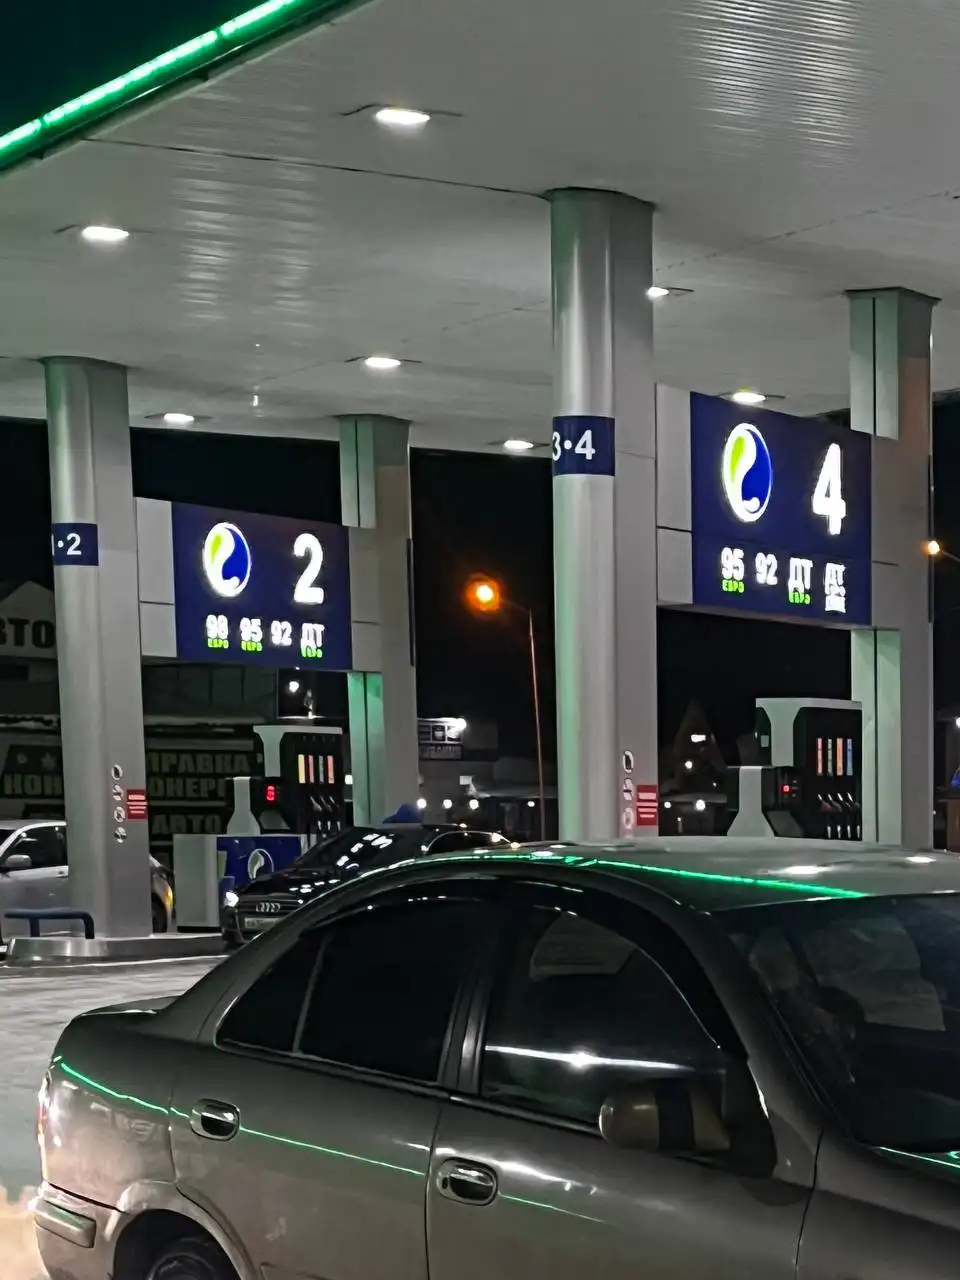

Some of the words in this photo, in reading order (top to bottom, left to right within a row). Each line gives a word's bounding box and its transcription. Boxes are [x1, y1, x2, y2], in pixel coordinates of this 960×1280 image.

[812, 443, 847, 535] 4
[293, 532, 325, 605] 2
[721, 546, 745, 580] 95
[755, 552, 778, 585] 92
[240, 617, 263, 642] 95
[270, 620, 293, 646] 92
